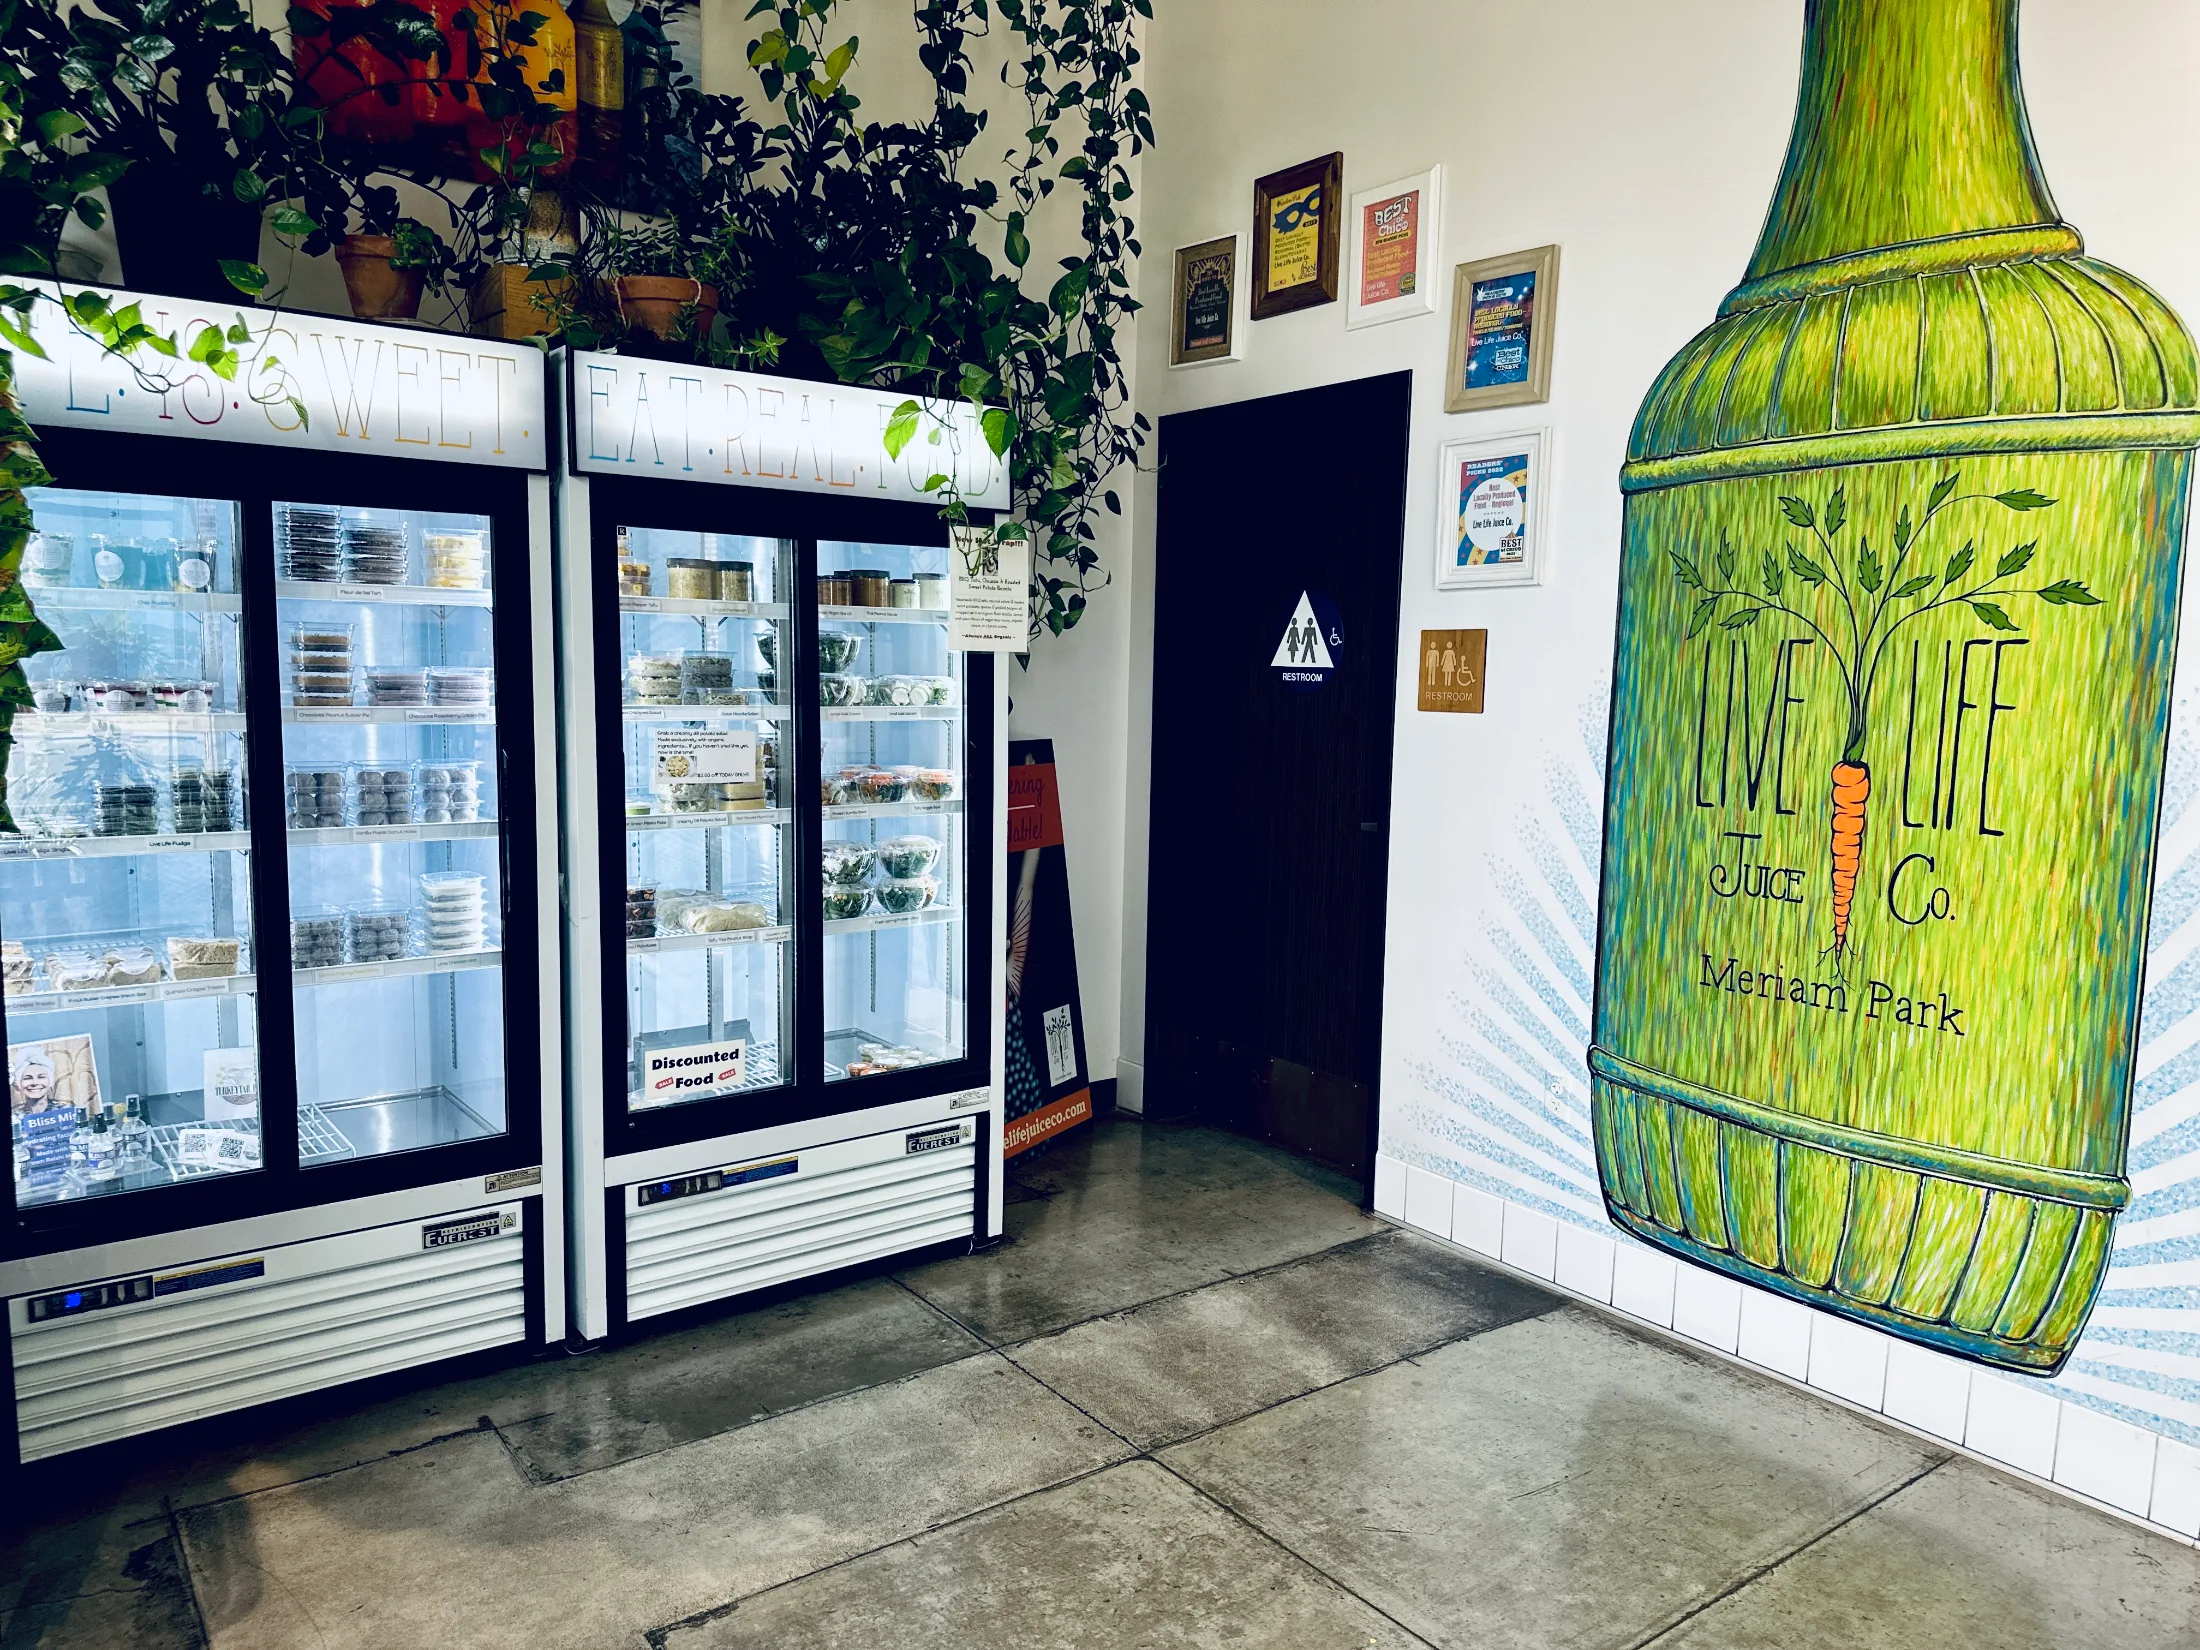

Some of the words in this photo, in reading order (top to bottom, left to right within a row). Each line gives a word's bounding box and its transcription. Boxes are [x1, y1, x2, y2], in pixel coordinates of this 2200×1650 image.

[1374, 196, 1412, 227] BEST
[1378, 221, 1409, 237] Chico
[1471, 337, 1483, 347] Live
[1484, 335, 1495, 345] Life
[1495, 333, 1512, 343] Juice
[1496, 348, 1520, 359] Best
[263, 328, 529, 454] SWEET.
[587, 365, 713, 471] EAT.
[724, 384, 864, 487] REAL.
[1466, 468, 1486, 477] PICKS
[1489, 484, 1501, 492] Best
[1473, 493, 1492, 503] Locally
[1492, 490, 1516, 500] Produced
[1474, 502, 1487, 510] Food
[1492, 500, 1514, 510] Regional
[1473, 519, 1483, 529] Live
[1483, 519, 1492, 529] Life
[1492, 517, 1505, 528] Juice
[1500, 538, 1522, 548] BEST
[1282, 672, 1323, 682] RESTROOM
[1425, 691, 1473, 702] RESTROOM
[1696, 638, 1815, 816] LIVE
[1903, 638, 2030, 837] LIFE
[1699, 954, 1849, 1013] Meriam
[1865, 980, 1966, 1036] Park
[651, 1048, 740, 1071] Discounted
[657, 1078, 674, 1088] SALE
[675, 1072, 714, 1089] Food
[720, 1069, 736, 1080] SALE
[27, 1116, 57, 1129] Bliss
[57, 1111, 77, 1123] Mis
[1003, 1100, 1087, 1150] elifejuiceco.com
[22, 1135, 57, 1147] Hydrating
[907, 1136, 959, 1153] EVEREST
[36, 1149, 54, 1157] Made
[424, 1225, 497, 1248] EVEREST
